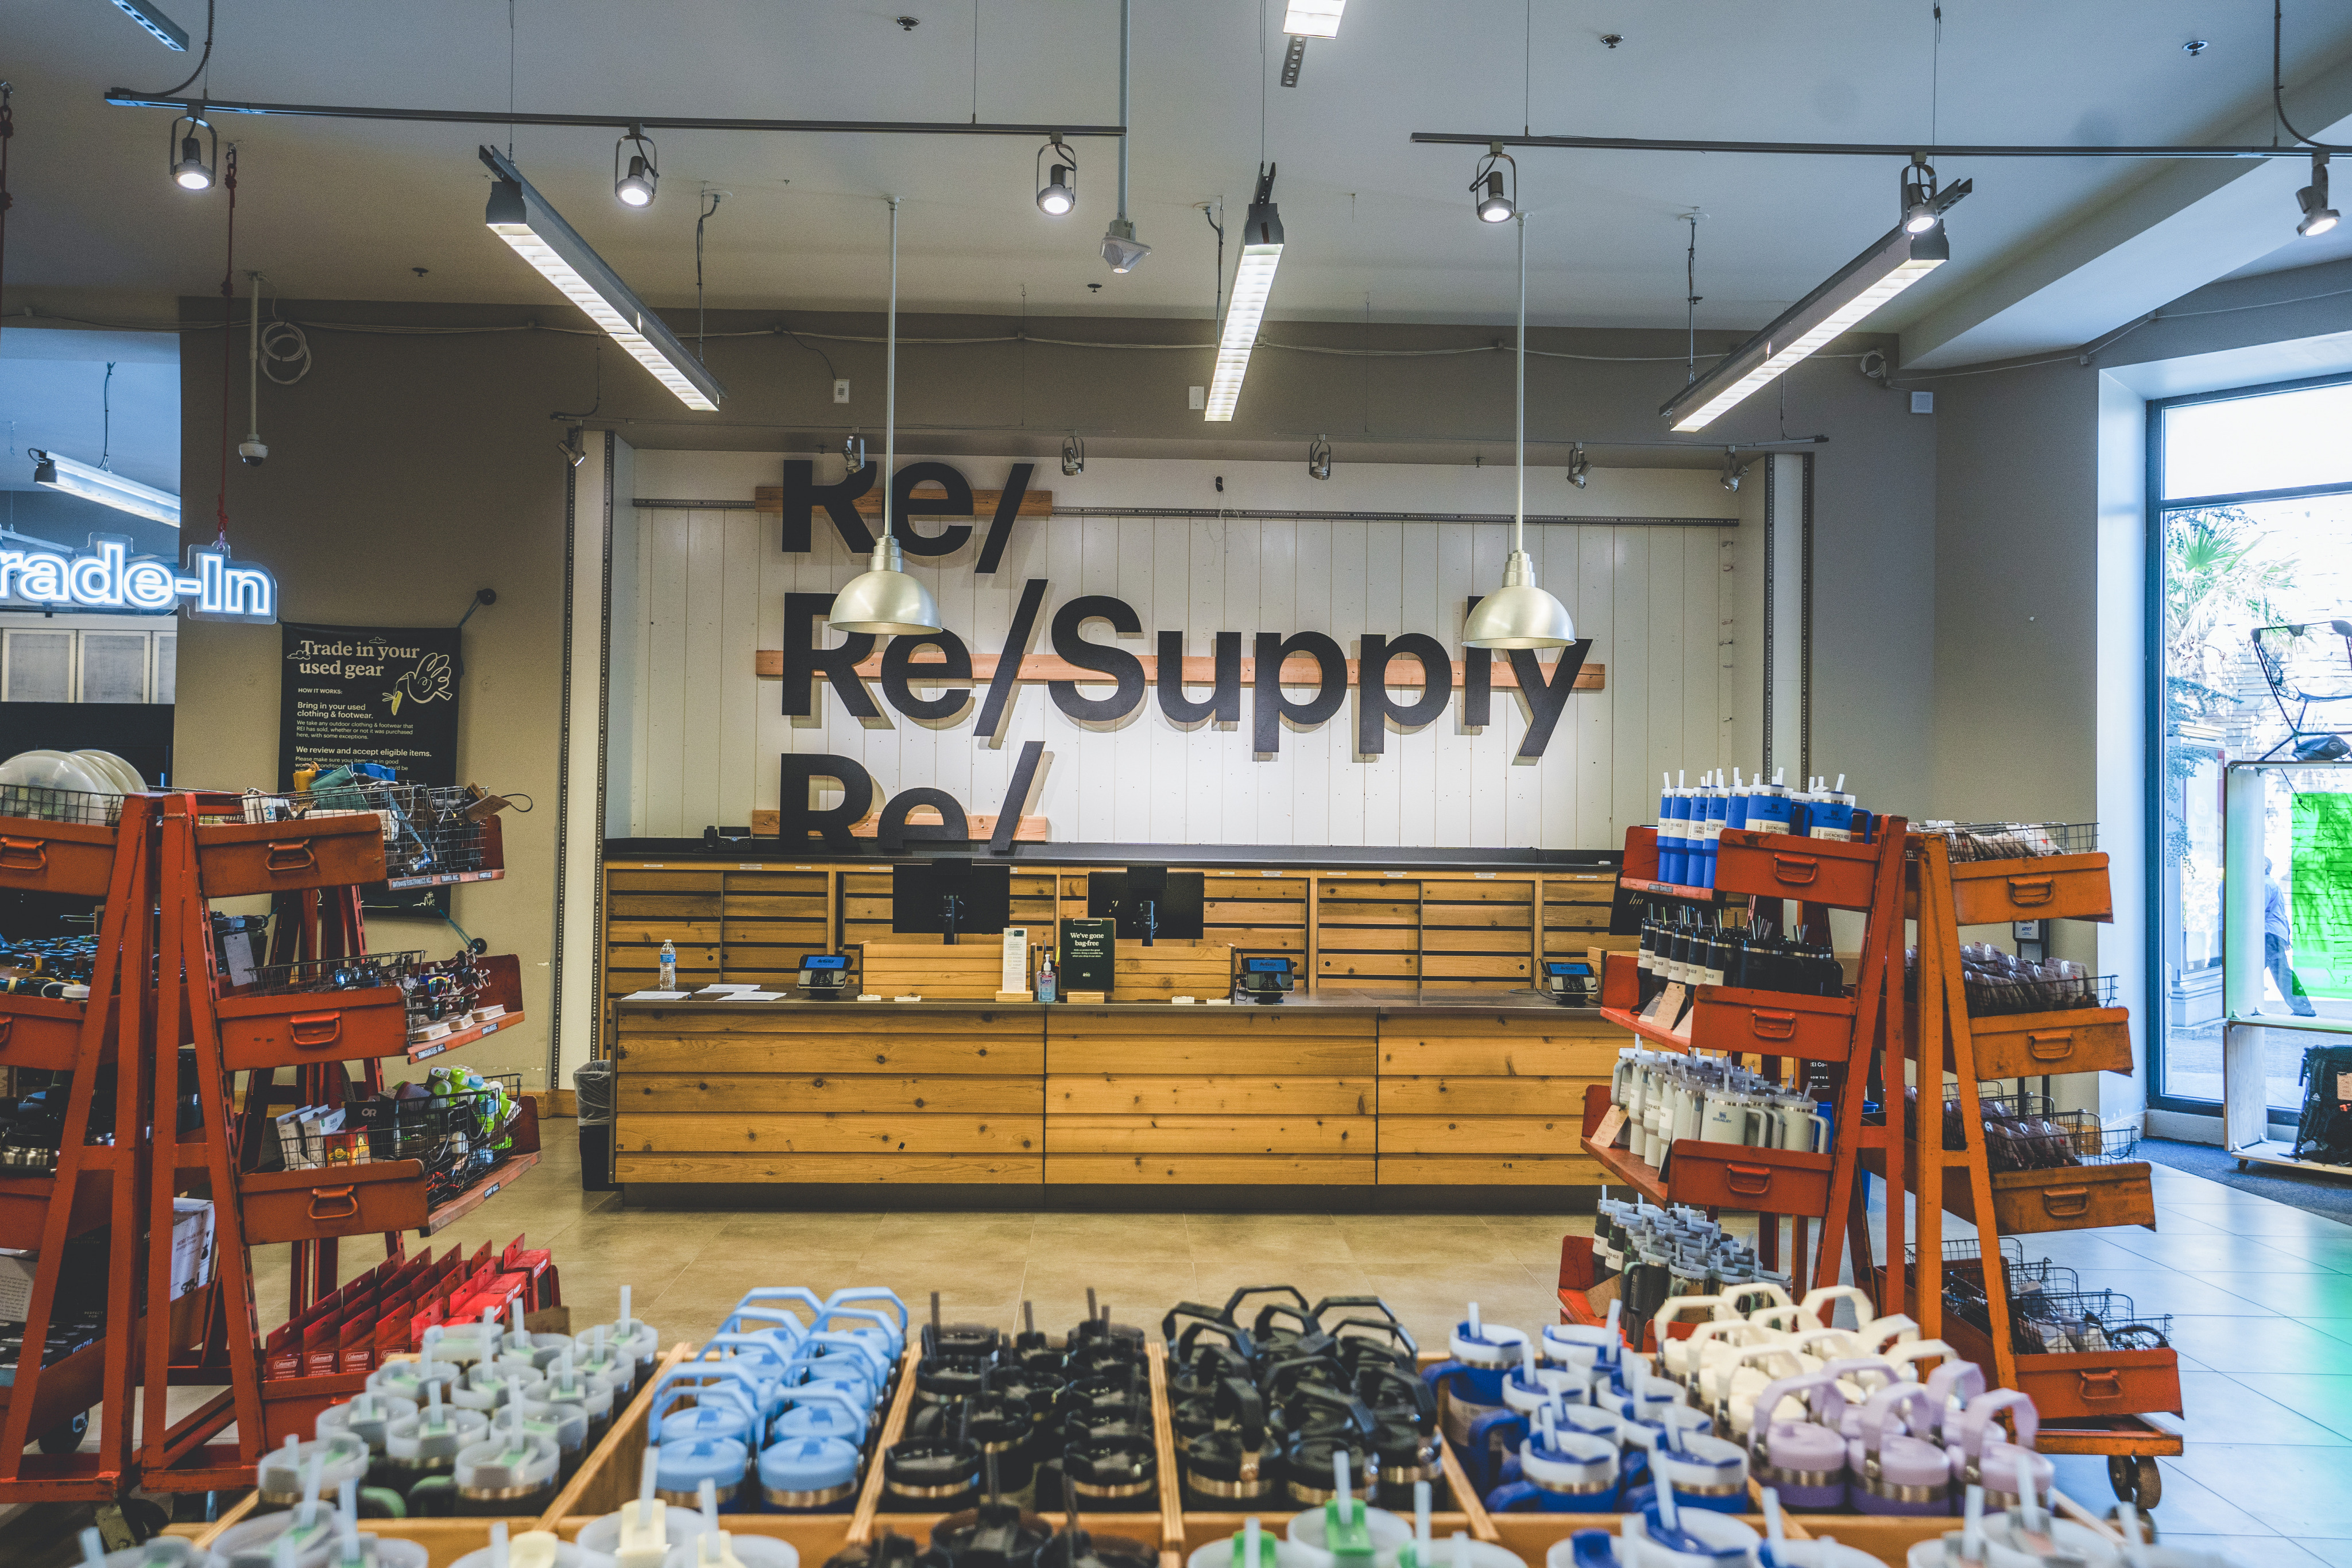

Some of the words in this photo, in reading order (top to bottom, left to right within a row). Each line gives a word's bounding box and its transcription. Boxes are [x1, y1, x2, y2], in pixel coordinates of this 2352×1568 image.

[0, 542, 272, 616] rade-In
[300, 640, 353, 656] Trade
[356, 641, 374, 657] in
[378, 646, 420, 661] your
[299, 660, 341, 675] used
[345, 664, 385, 679] gear
[782, 579, 1592, 758] Re/Supply
[298, 702, 318, 710] Bring
[297, 710, 329, 719] clothing
[380, 748, 408, 757] eligible
[361, 1108, 377, 1117] OR
[485, 1187, 493, 1197] CAMP
